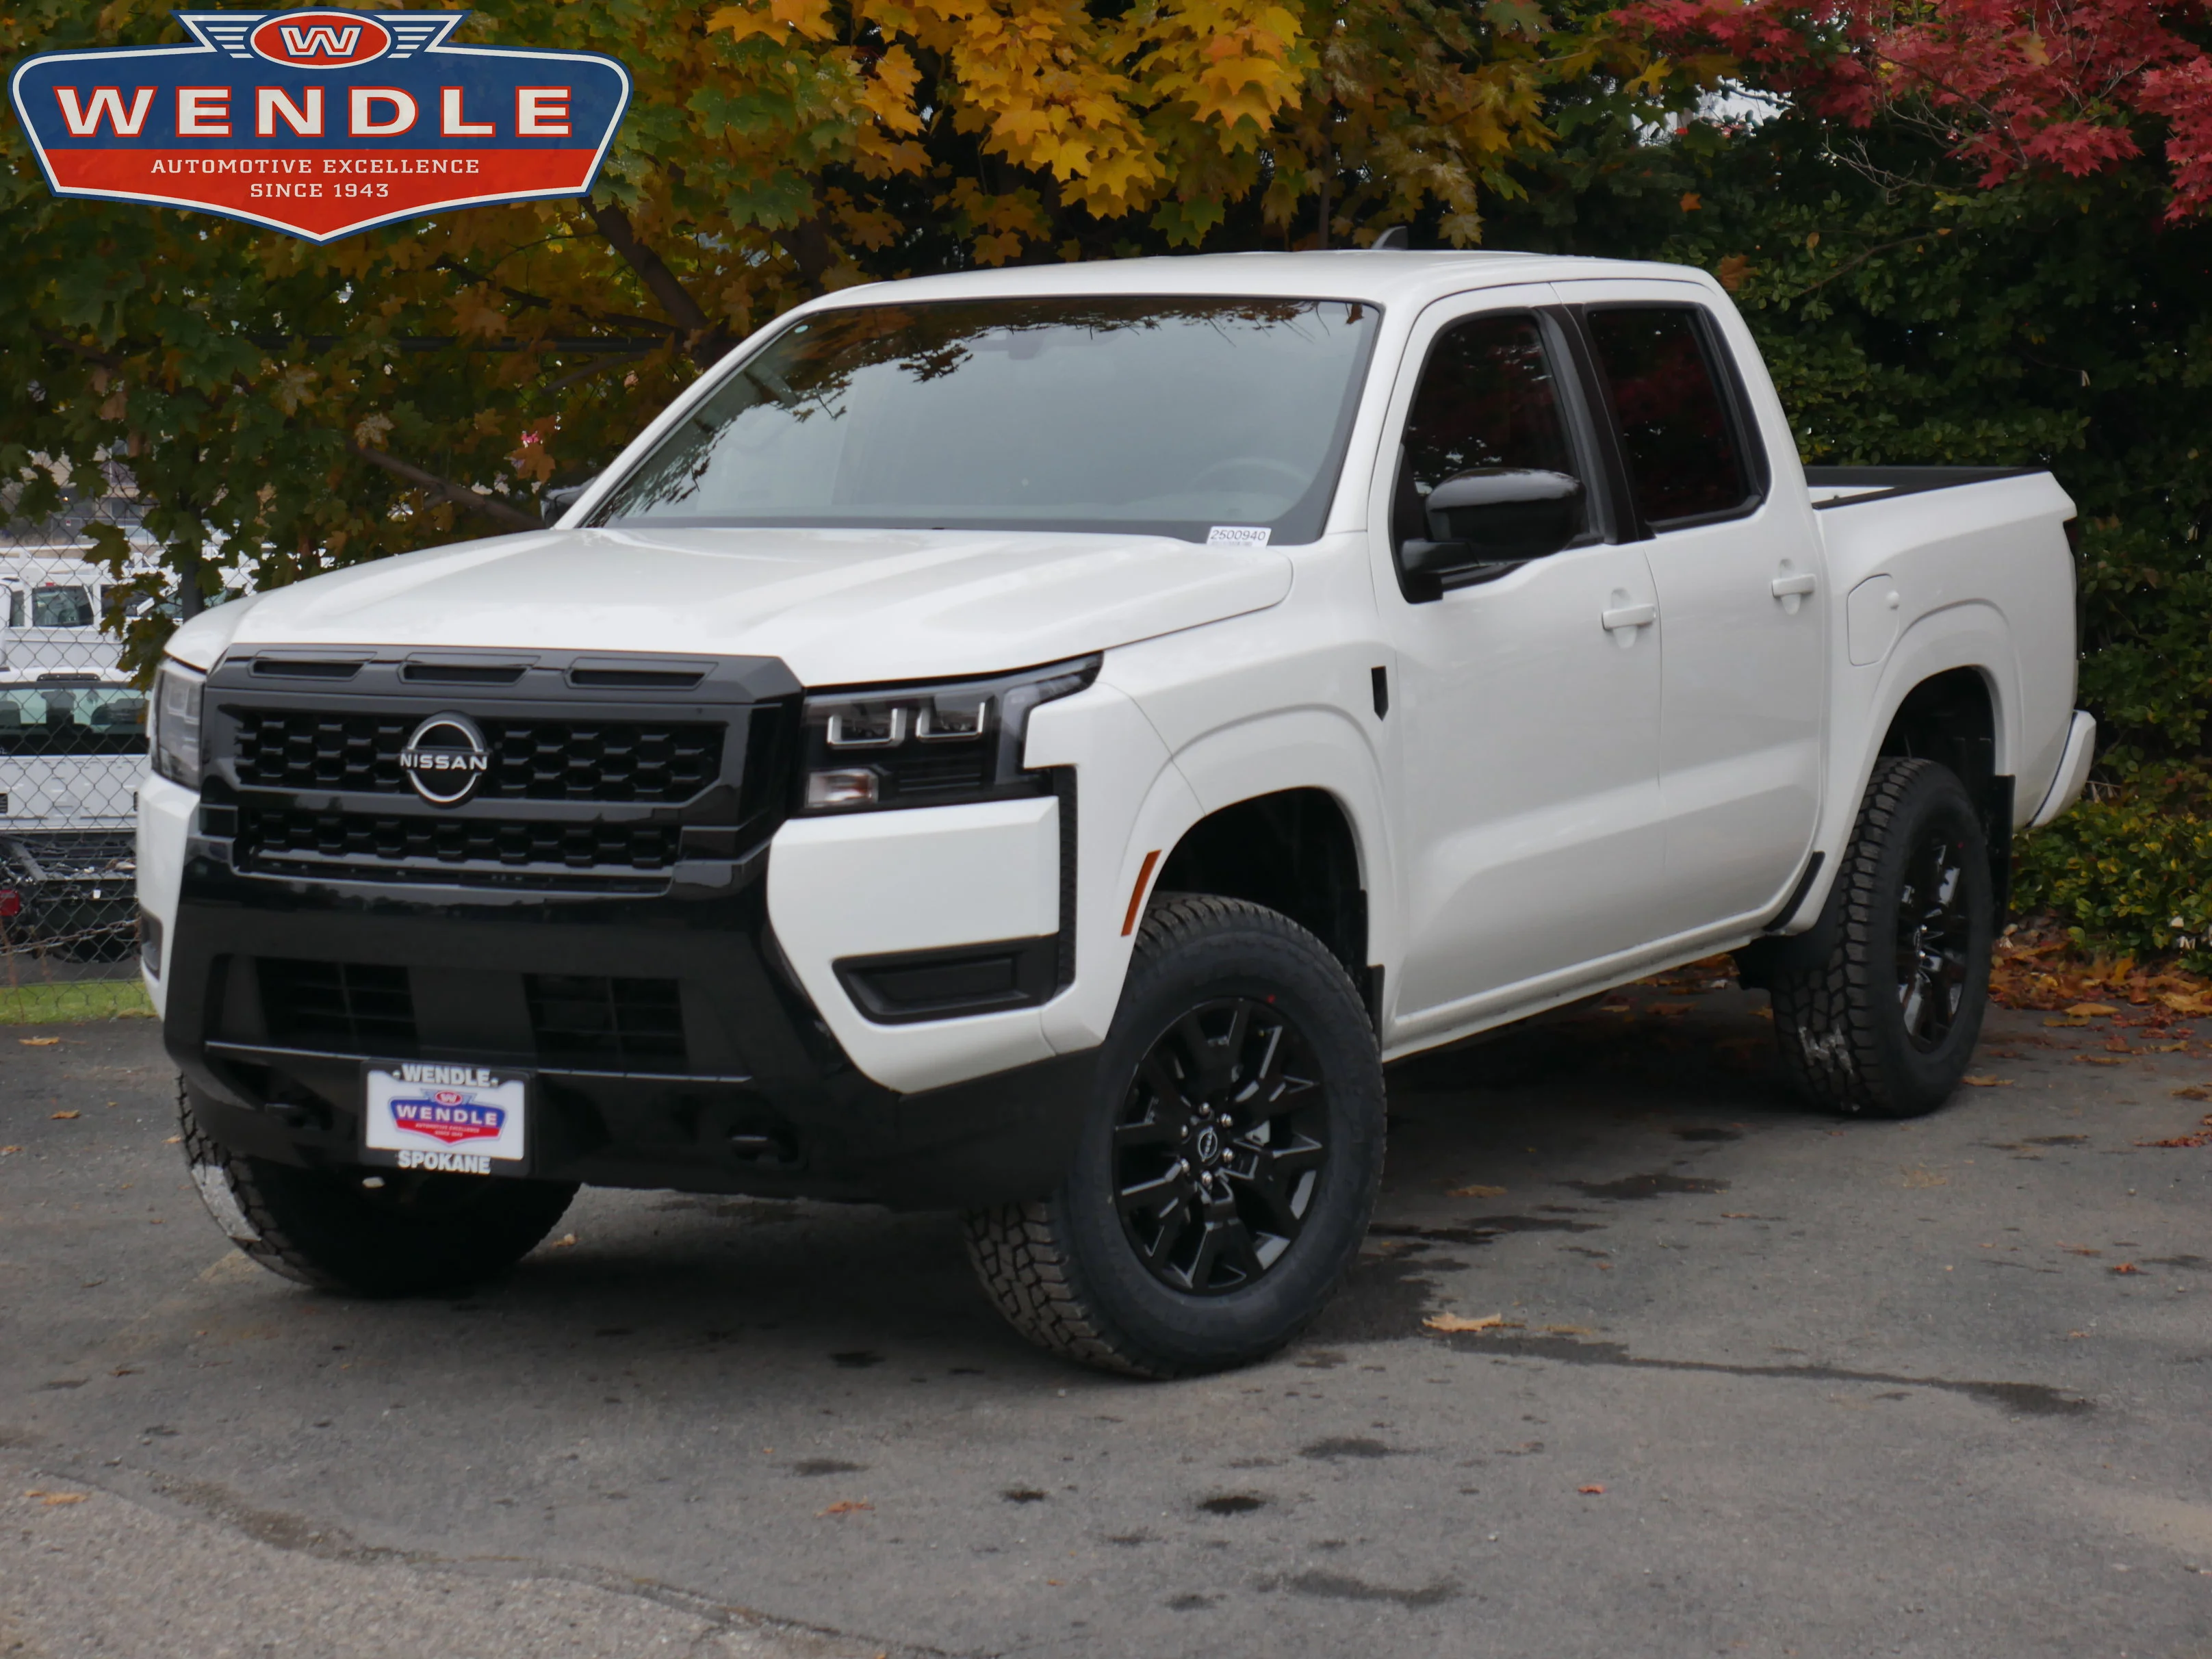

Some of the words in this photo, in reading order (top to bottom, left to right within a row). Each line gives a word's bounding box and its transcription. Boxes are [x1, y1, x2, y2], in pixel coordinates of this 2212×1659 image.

[1210, 529, 1266, 541] 2500940
[400, 752, 488, 770] NISSAN
[402, 1063, 491, 1088] WENDLE
[396, 1105, 498, 1126] WENDLE
[398, 1149, 491, 1174] SPOKANE
